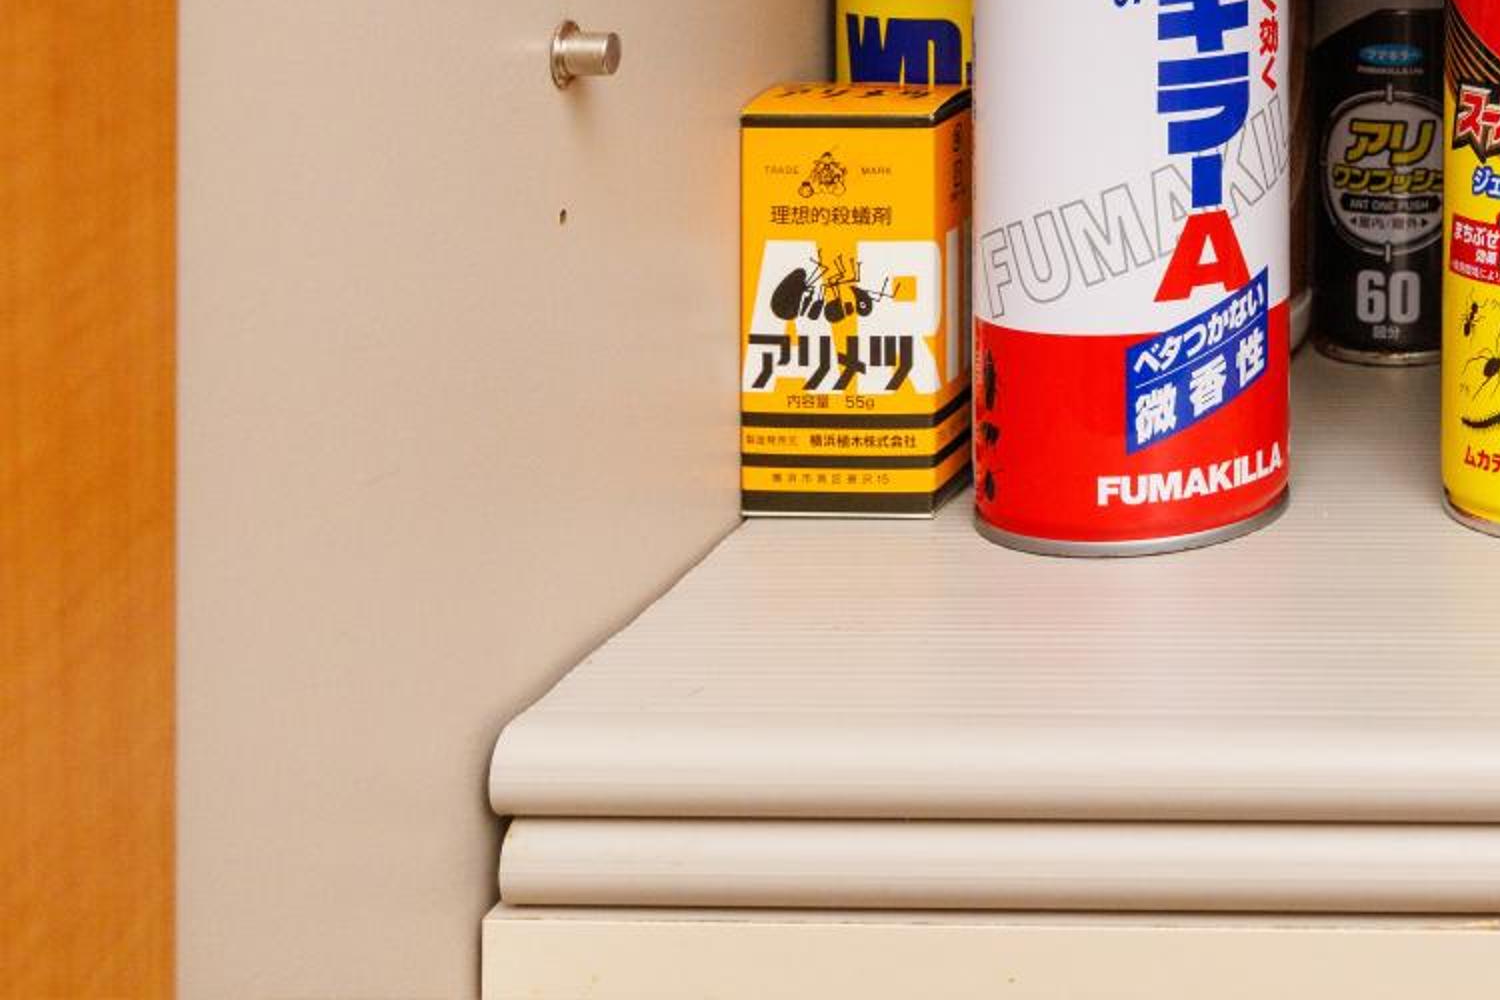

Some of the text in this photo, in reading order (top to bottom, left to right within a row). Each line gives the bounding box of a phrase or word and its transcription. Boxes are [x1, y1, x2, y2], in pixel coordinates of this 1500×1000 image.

[847, 13, 971, 85] WD
[1345, 118, 1437, 167] アリ
[770, 205, 892, 226] 理想的殺蟻剤
[1453, 220, 1500, 250] まちぶせ
[1357, 270, 1421, 324] 60
[1133, 284, 1265, 374] ベタつかない
[748, 335, 913, 392] アリメツ
[1135, 330, 1266, 446] 微香性
[787, 396, 875, 410] 内容量 55g
[810, 433, 917, 449] 横浜植木株式会社
[1097, 442, 1282, 507] FUMAKILLA
